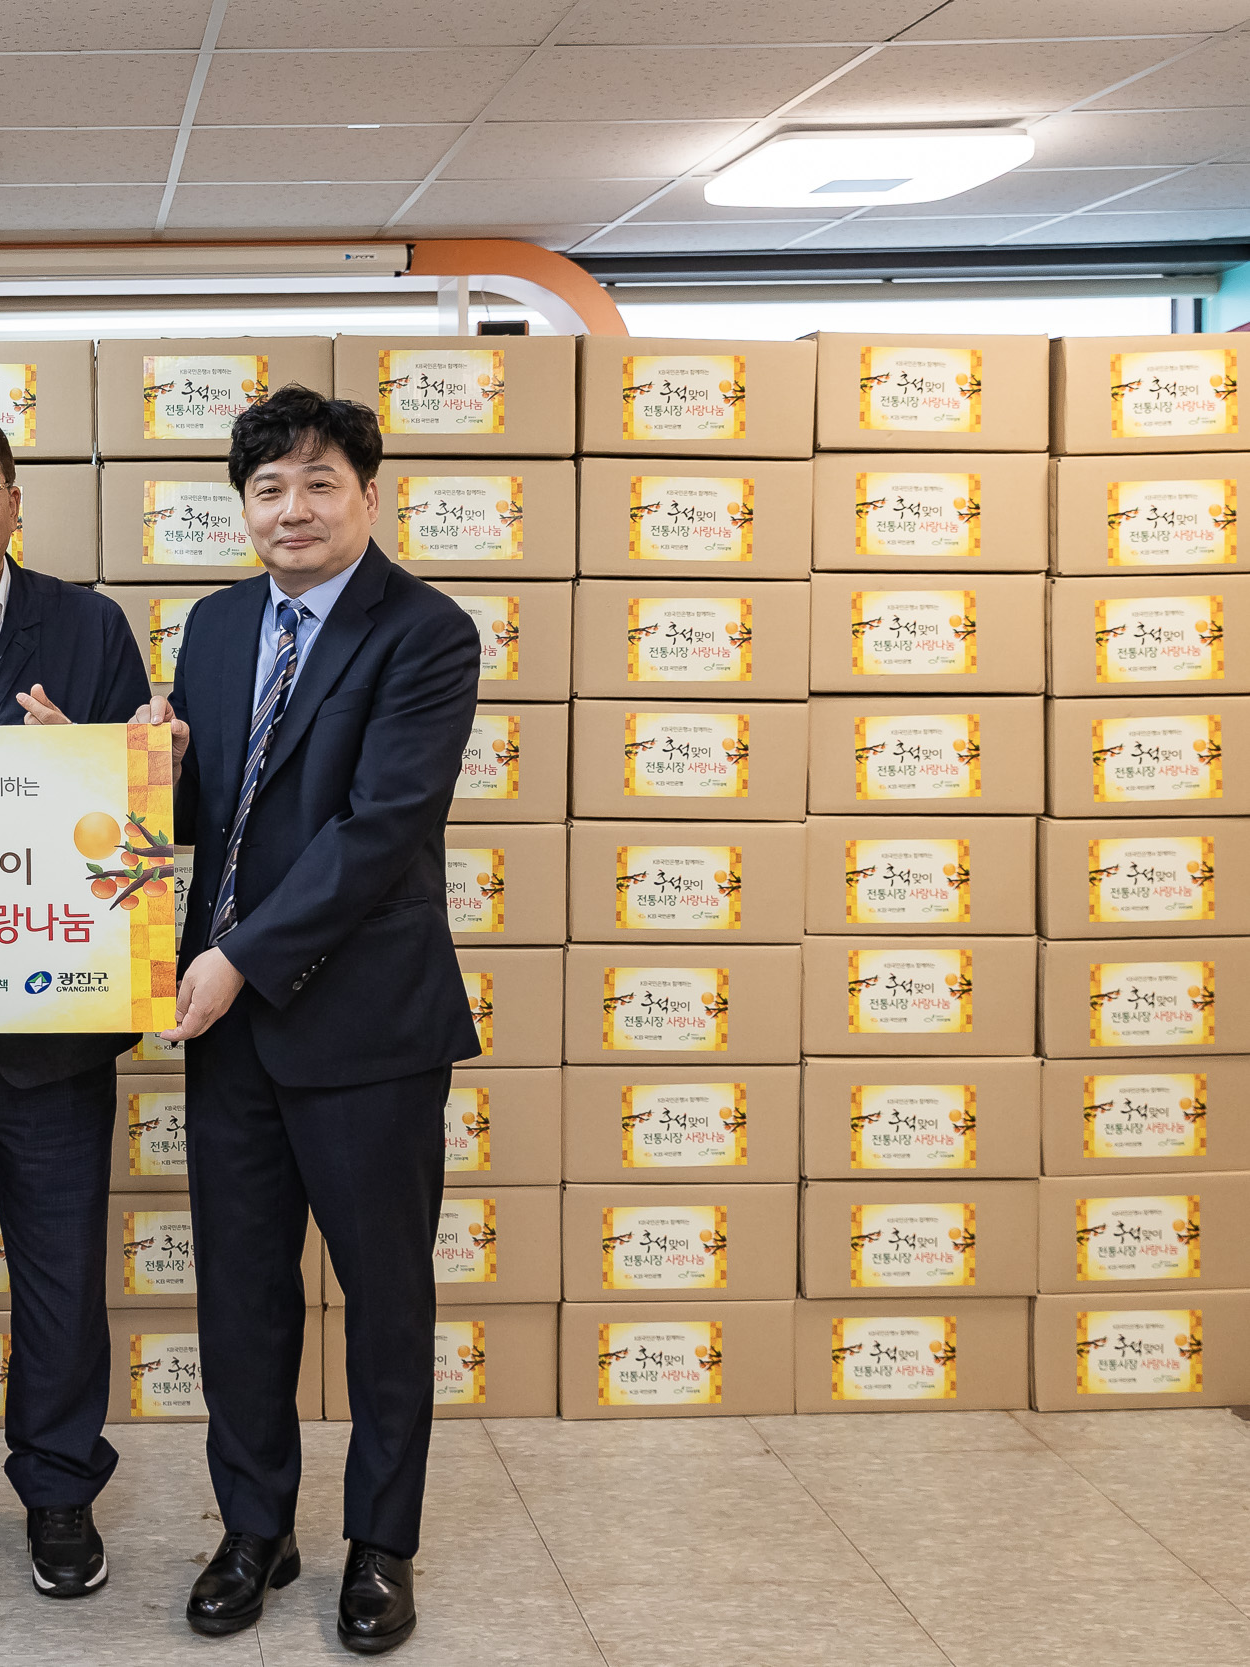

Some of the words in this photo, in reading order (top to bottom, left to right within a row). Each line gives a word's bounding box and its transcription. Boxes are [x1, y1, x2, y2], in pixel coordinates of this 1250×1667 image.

[181, 379, 230, 402] 추석맞이
[417, 374, 466, 397] 추석맞이
[660, 380, 708, 403] 추석맞이
[897, 371, 944, 394] 추석맞이
[1149, 376, 1198, 400] 추석맞이
[165, 404, 205, 415] 전통시장
[401, 399, 440, 410] 전통시장
[443, 399, 483, 410] 사랑나눔
[644, 405, 683, 417] 전통시장
[685, 405, 725, 416] 사랑나눔
[181, 505, 230, 529] 추석맞이
[436, 500, 484, 524] 추석맞이
[667, 500, 716, 524] 추석맞이
[893, 496, 942, 519] 추석맞이
[1146, 505, 1197, 529] 추석맞이
[165, 530, 204, 542] 전통시장
[420, 525, 459, 537] 전통시장
[462, 525, 502, 537] 사랑나눔
[651, 525, 690, 537] 전통시장
[692, 526, 732, 538] 사랑나눔
[665, 621, 714, 645] 추석맞이
[889, 615, 938, 638] 추석맞이
[1134, 622, 1184, 645] 추석맞이
[649, 647, 688, 658] 전통시장
[691, 647, 731, 658] 사랑나눔
[662, 737, 711, 760] 추석맞이
[893, 740, 942, 763] 추석맞이
[1131, 741, 1181, 765] 추석맞이
[646, 762, 685, 773] 전통시장
[688, 762, 727, 774] 사랑나눔
[654, 869, 703, 893] 추석맞이
[883, 863, 932, 887] 추석맞이
[1126, 862, 1175, 885] 추석맞이
[637, 895, 677, 906] 전통시장
[680, 895, 720, 906] 사랑나눔
[57, 972, 108, 985] 광진구
[885, 973, 934, 997] 추석맞이
[641, 991, 690, 1014] 추석맞이
[1128, 986, 1176, 1010] 추석맞이
[624, 1016, 664, 1028] 전통시장
[666, 1017, 706, 1028] 사랑나눔
[659, 1108, 708, 1131] 추석맞이
[888, 1109, 937, 1133] 추석맞이
[643, 1133, 683, 1145] 전통시장
[685, 1132, 725, 1143] 사랑나눔
[640, 1230, 688, 1253] 추석맞이
[888, 1228, 937, 1251] 추석맞이
[145, 1260, 185, 1271] 전통시장
[435, 1248, 475, 1260] 사랑나눔
[624, 1255, 663, 1266] 전통시장
[665, 1254, 705, 1266] 사랑나눔
[635, 1346, 684, 1369] 추석맞이
[870, 1341, 918, 1364] 추석맞이
[152, 1382, 192, 1393] 전통시장
[620, 1371, 658, 1382] 전통시장
[661, 1370, 700, 1381] 사랑나눔
